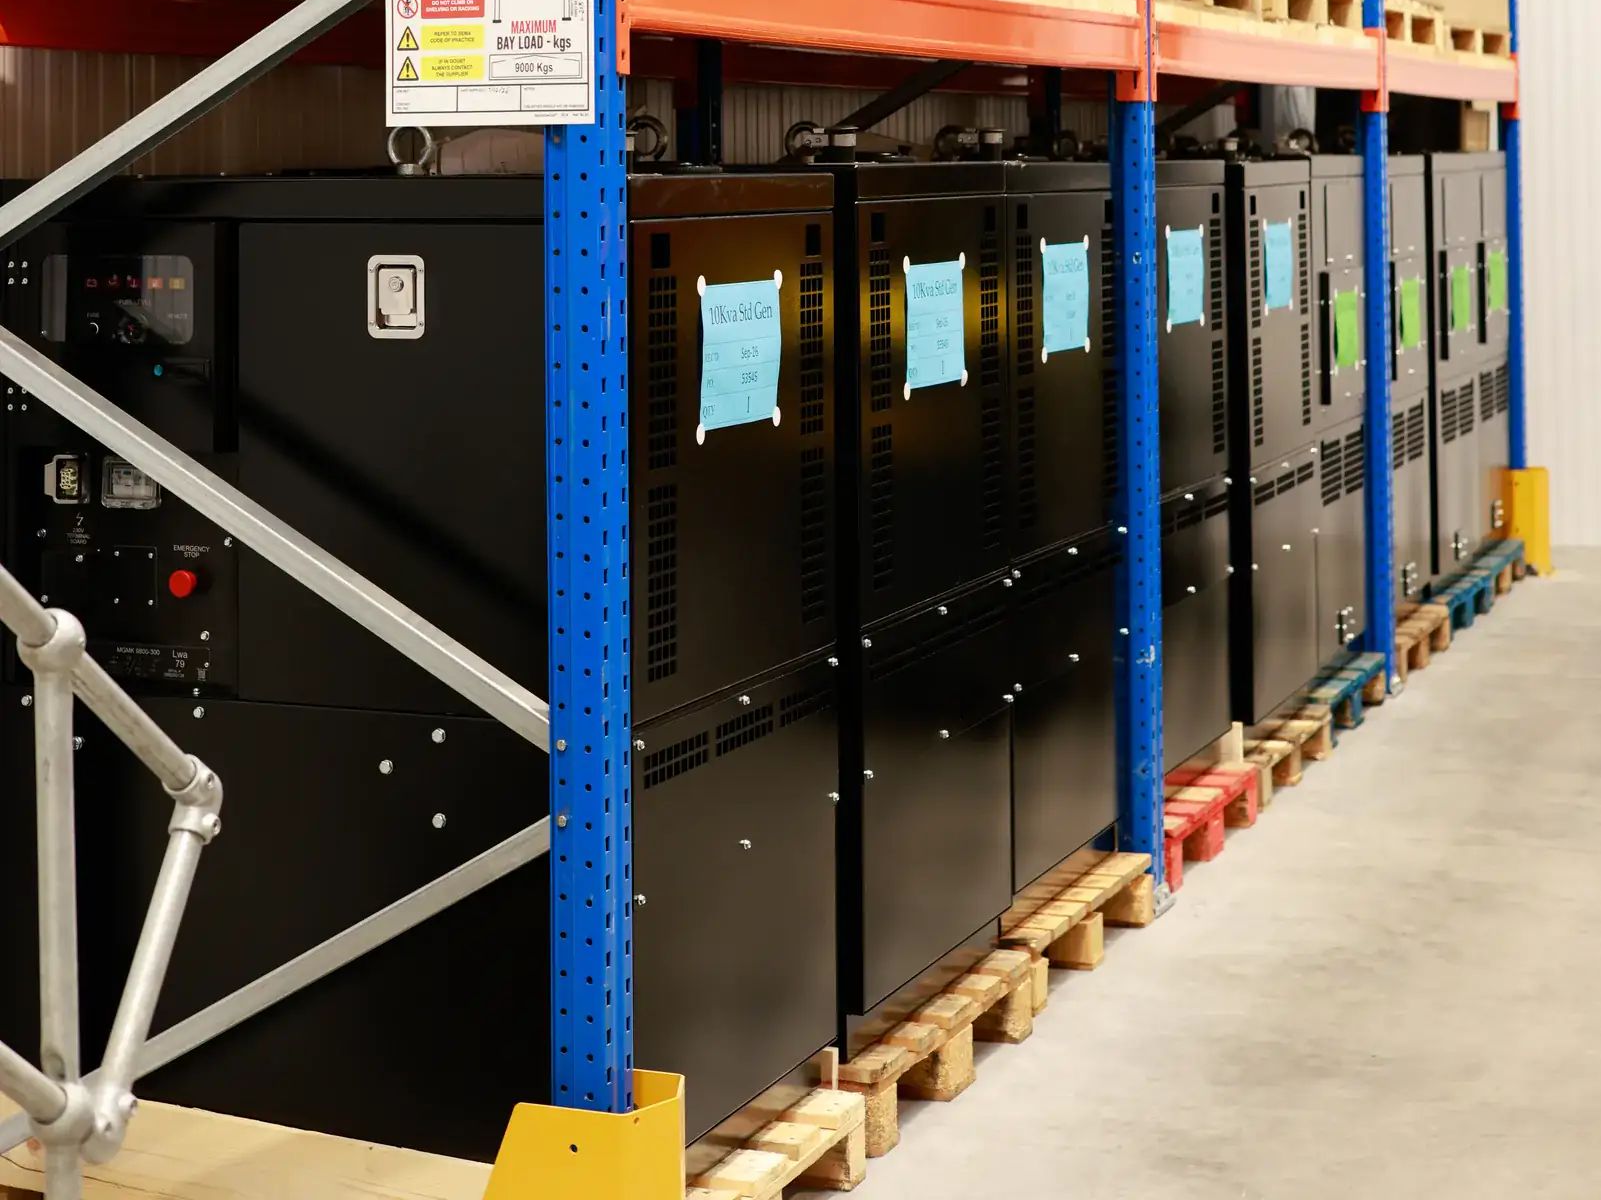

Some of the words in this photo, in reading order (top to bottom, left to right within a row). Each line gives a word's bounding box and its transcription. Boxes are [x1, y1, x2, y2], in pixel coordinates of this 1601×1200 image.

[511, 20, 556, 34] MAXIMUM
[497, 36, 515, 50] BAY
[518, 35, 543, 49] LOAD
[553, 34, 571, 52] kgs
[515, 62, 534, 73] 9000
[537, 62, 554, 75] Kgs
[709, 304, 738, 325] 10Kva
[738, 302, 753, 322] Std
[754, 301, 773, 320] Gen
[173, 544, 210, 553] EMERGENCY
[172, 650, 188, 659] Lwa
[175, 660, 185, 668] 79
